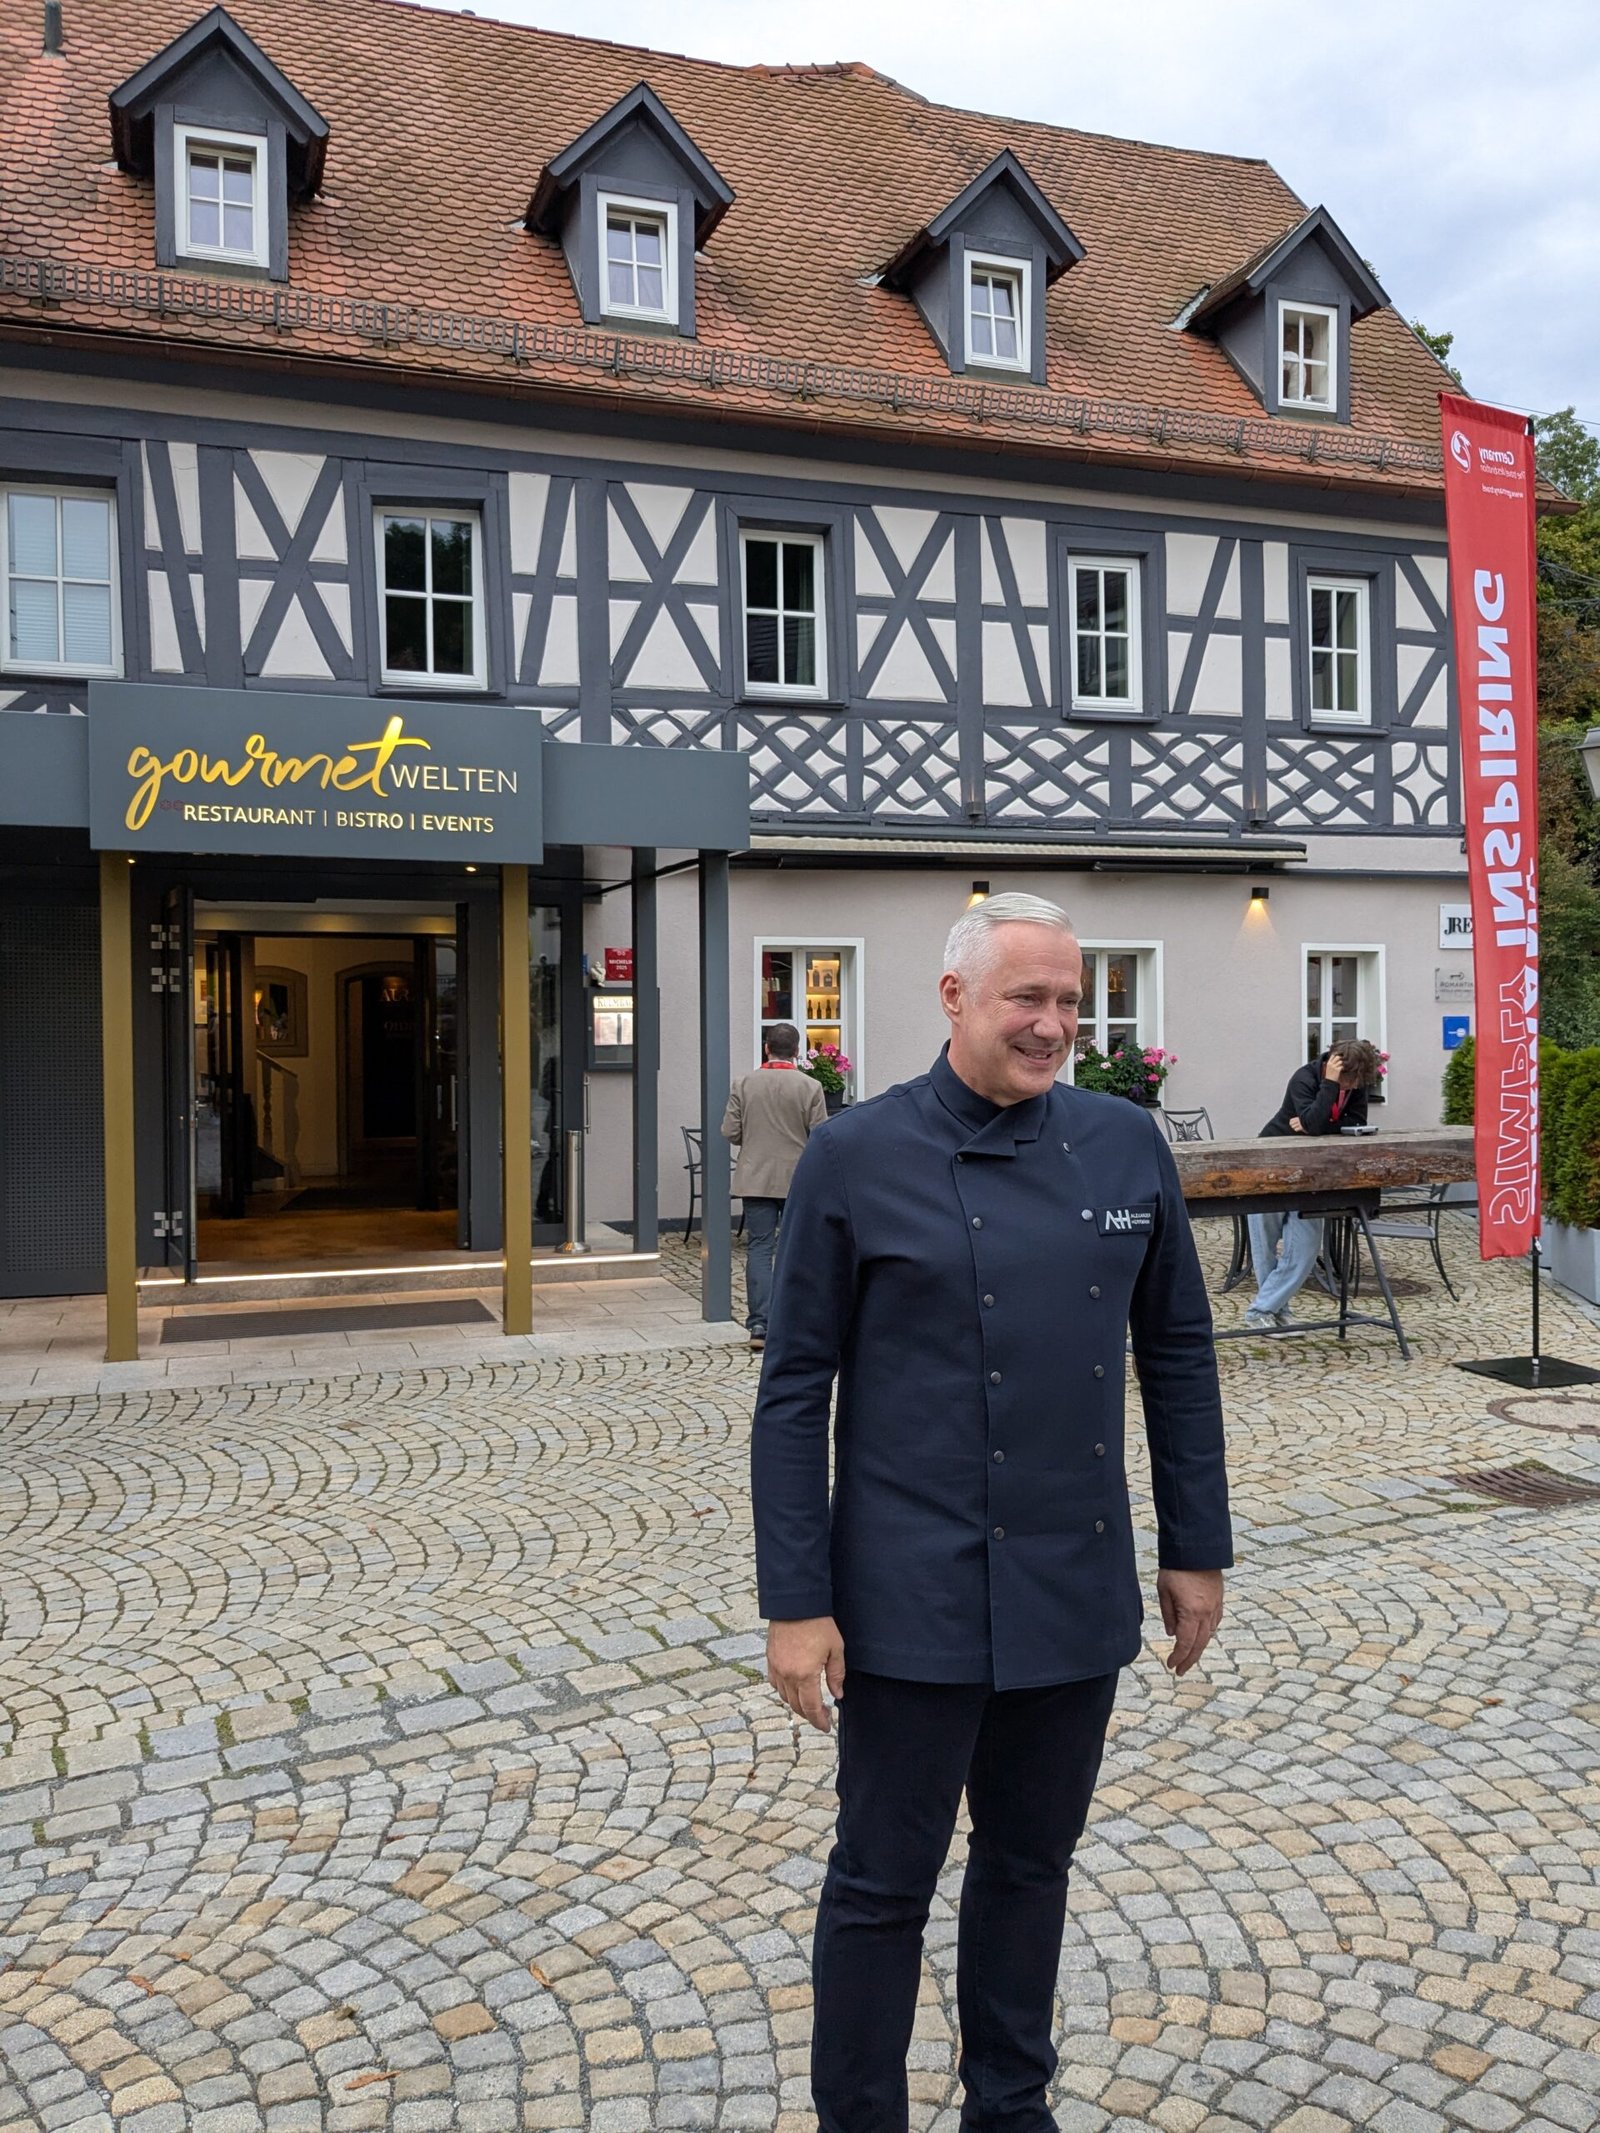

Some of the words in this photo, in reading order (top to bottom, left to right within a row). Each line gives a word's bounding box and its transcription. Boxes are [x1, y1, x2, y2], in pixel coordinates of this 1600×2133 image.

[125, 714, 431, 831] gourmet
[388, 763, 518, 794] WELTEN
[183, 804, 317, 827] RESTAURANT
[336, 810, 404, 830] BISTRO
[421, 813, 494, 834] EVENTS
[1444, 917, 1473, 935] JRE
